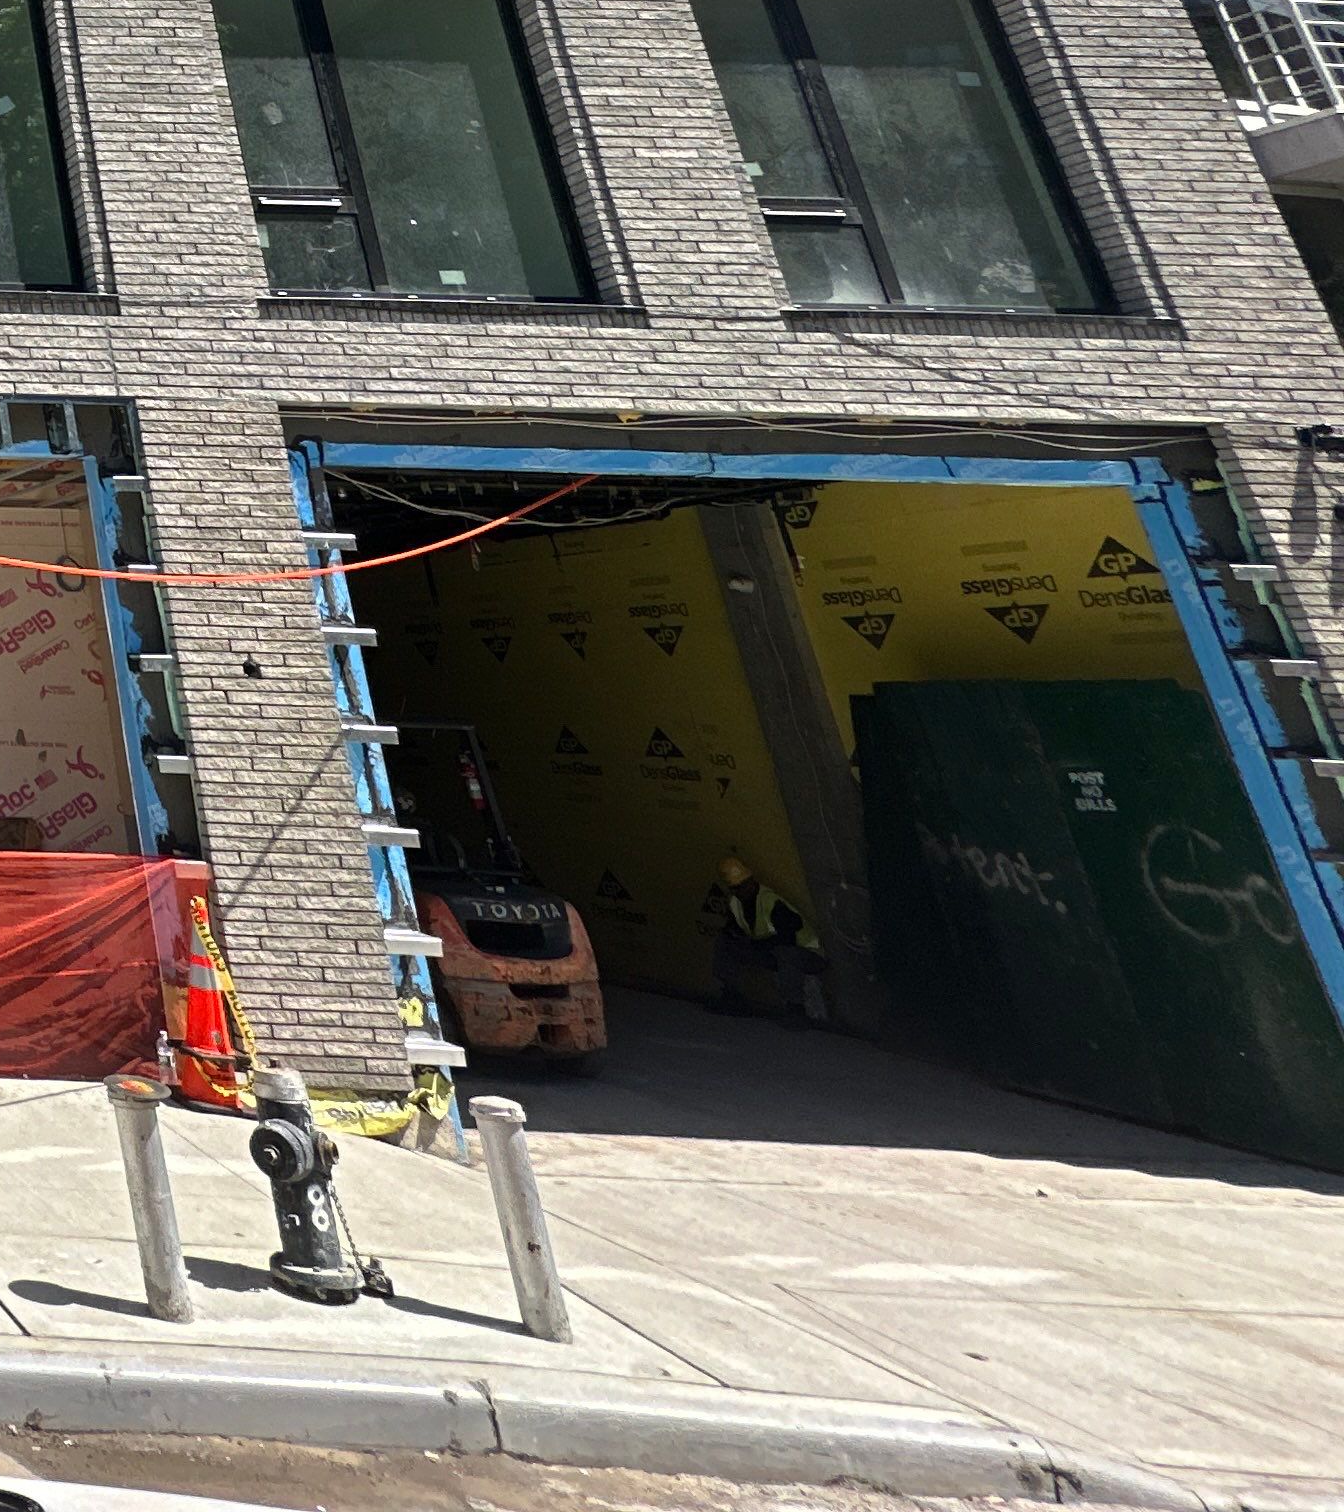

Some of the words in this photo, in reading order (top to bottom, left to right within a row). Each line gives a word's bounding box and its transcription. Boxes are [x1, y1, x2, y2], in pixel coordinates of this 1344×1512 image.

[1097, 552, 1137, 574] GP
[822, 586, 903, 607] DensGlass
[960, 574, 1059, 598] DensGlass
[857, 616, 888, 636] GP
[1002, 606, 1040, 629] GP
[1068, 771, 1104, 785] POST
